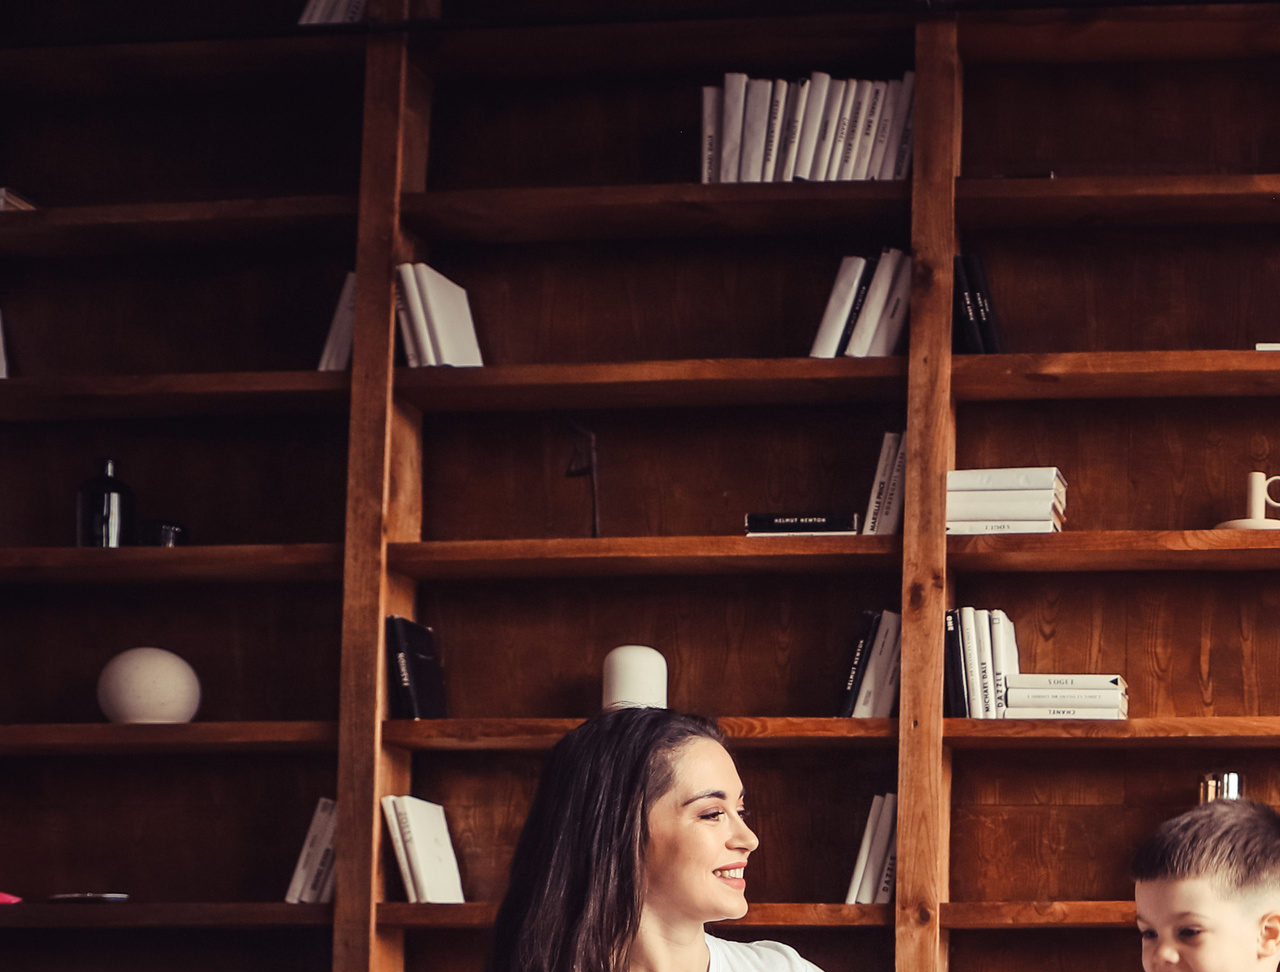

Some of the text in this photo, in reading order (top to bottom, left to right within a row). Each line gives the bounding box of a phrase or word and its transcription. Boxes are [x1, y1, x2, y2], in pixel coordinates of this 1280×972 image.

[869, 481, 886, 532] MARIELLE PRICE
[946, 615, 954, 631] ONE
[846, 639, 864, 691] HELMUT NEWTON
[982, 680, 990, 713] MICHAEL
[996, 672, 1004, 708] DAZZLE
[882, 855, 897, 892] DAZZLE
